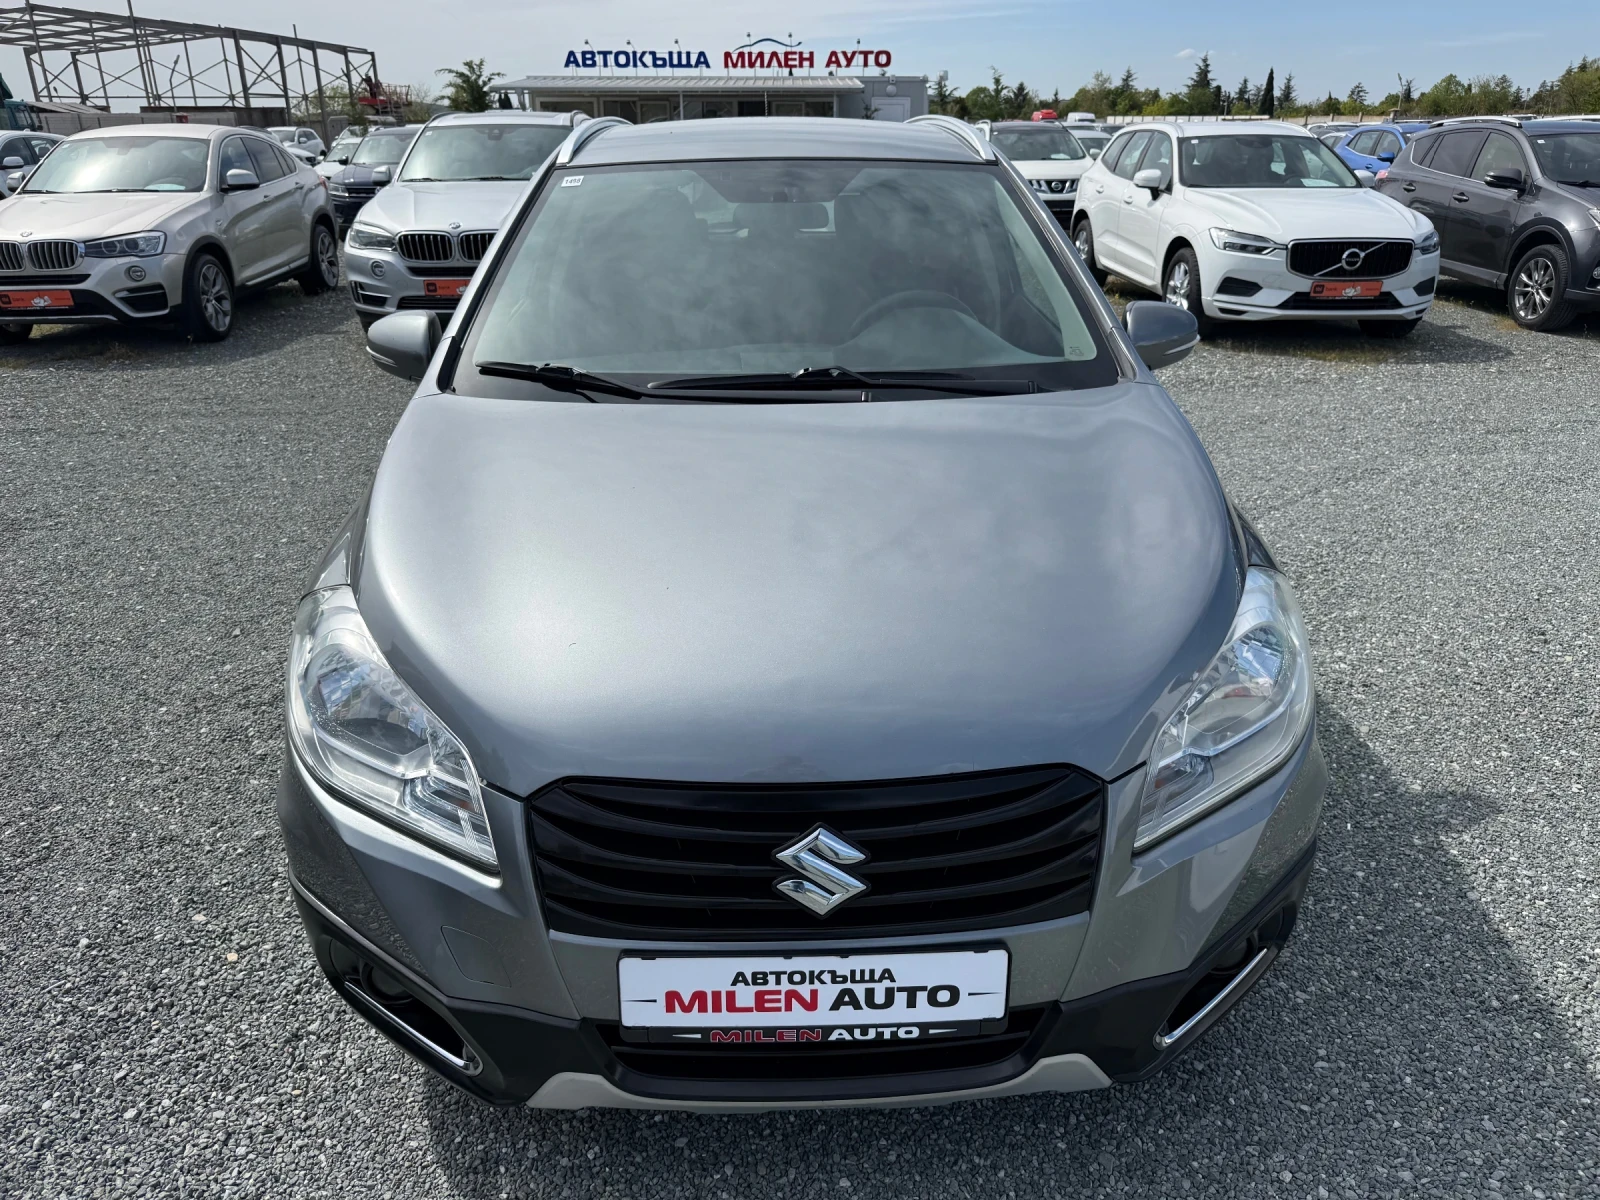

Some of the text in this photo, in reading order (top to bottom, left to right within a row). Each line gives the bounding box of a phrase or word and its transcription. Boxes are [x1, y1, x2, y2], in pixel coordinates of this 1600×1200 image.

[724, 51, 814, 68] МИЛЕН
[825, 50, 892, 68] АУТО
[664, 985, 960, 1013] MILEN AUTO
[710, 1027, 919, 1043] MILEN AUTO
